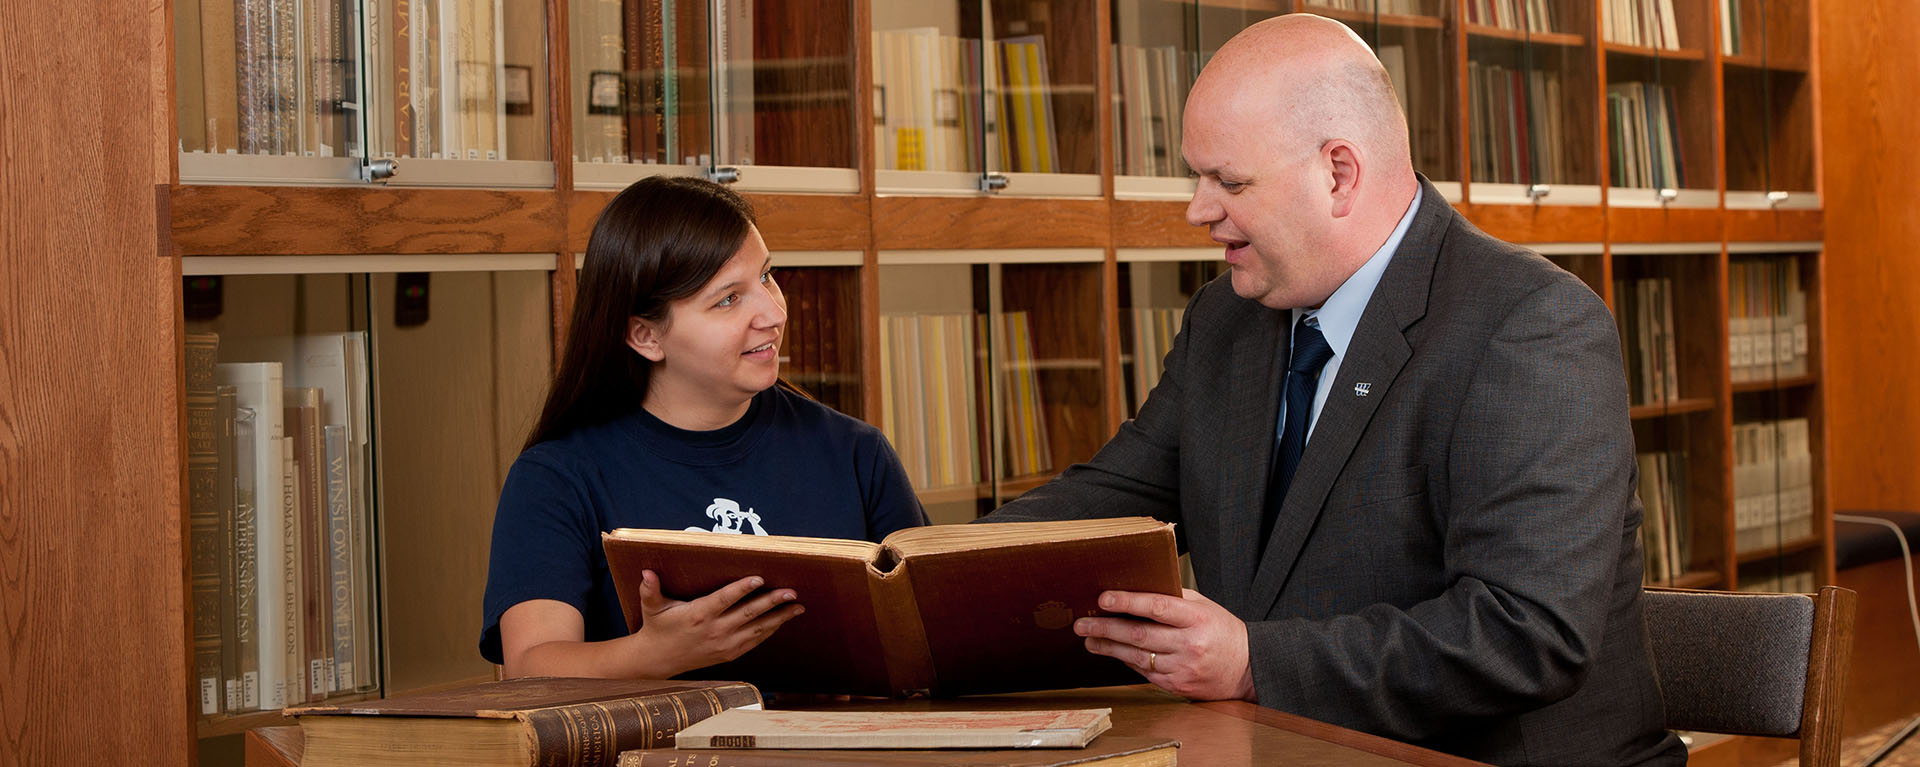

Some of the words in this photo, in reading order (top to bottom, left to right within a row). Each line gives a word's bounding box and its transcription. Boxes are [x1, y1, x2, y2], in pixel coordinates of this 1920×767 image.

[334, 3, 342, 68] Goldsworthy
[398, 65, 409, 143] CARL
[284, 472, 294, 538] THOMAS
[329, 456, 346, 562] WINSLOW
[238, 502, 249, 643] IMPRESSIONISM
[246, 502, 256, 598] AMERICAN
[285, 544, 295, 586] HART
[286, 592, 296, 656] BENTON
[334, 569, 351, 651] HOMER
[571, 708, 591, 766] TURESQUE
